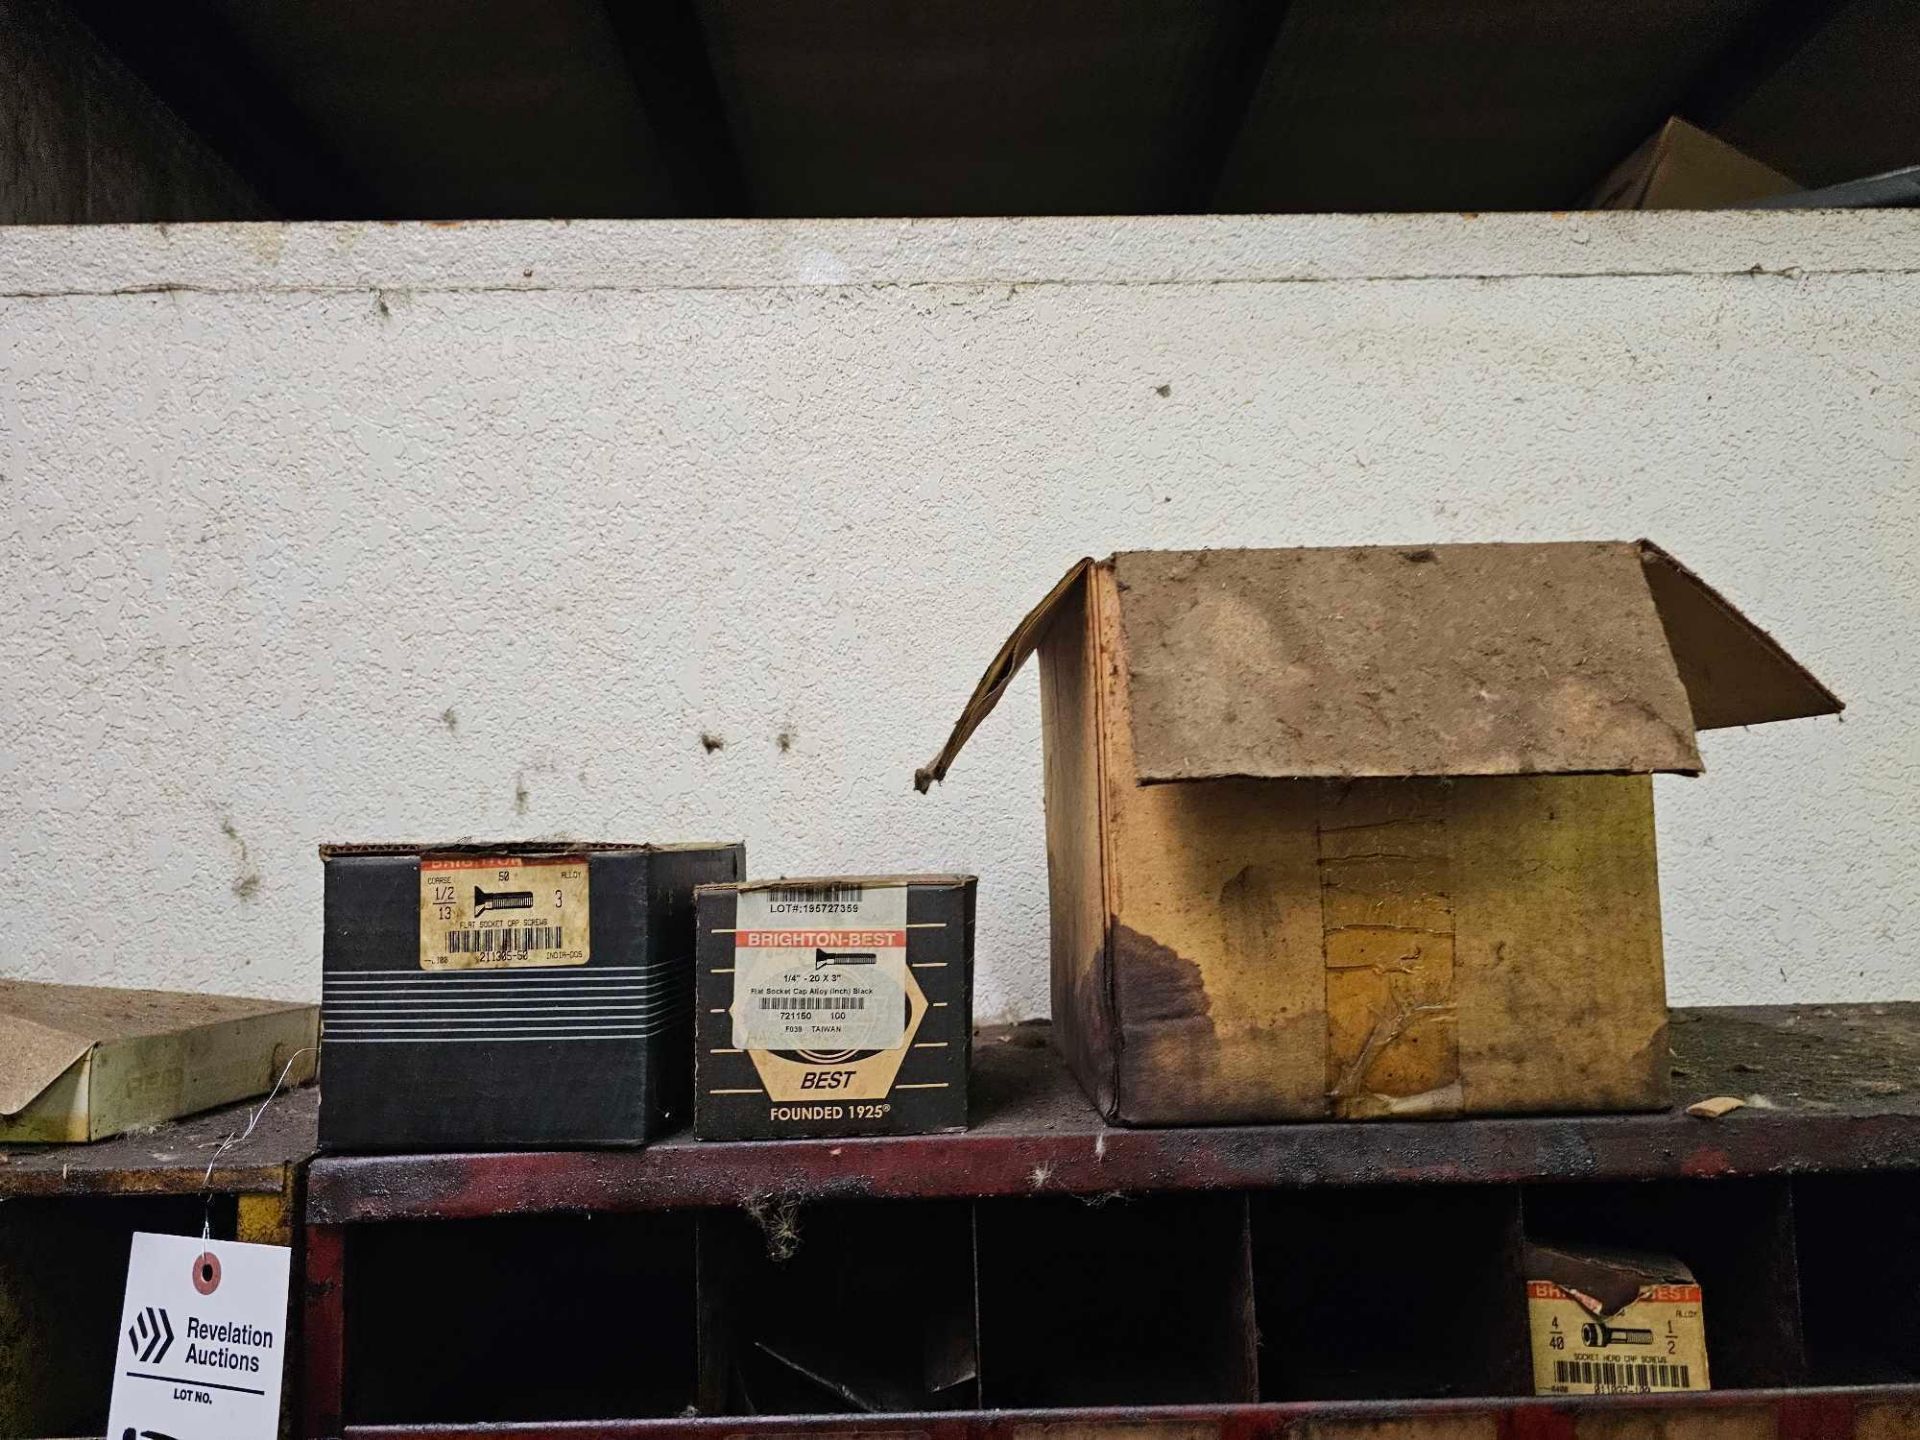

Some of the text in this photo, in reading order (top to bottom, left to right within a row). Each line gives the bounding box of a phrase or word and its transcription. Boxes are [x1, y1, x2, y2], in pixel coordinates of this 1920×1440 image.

[498, 871, 510, 882] 50
[434, 886, 455, 901] 1/2
[554, 889, 563, 909] 3
[438, 906, 452, 920] 13
[459, 918, 548, 929] FLAT SOCKET CAP SCREWS
[747, 932, 897, 947] BRIGHTON-BEST
[809, 974, 820, 982] 20
[823, 974, 829, 982] X
[793, 988, 808, 996] Cap
[809, 988, 828, 996] Alloy
[830, 1012, 846, 1020] 100
[800, 1070, 857, 1090] BEST
[770, 1106, 843, 1121] FOUNDED
[1551, 1316, 1559, 1330] 4
[1667, 1320, 1673, 1334] 1
[186, 1317, 273, 1348] Revelation
[1549, 1336, 1564, 1350] 40
[1667, 1341, 1676, 1355] 2
[185, 1343, 260, 1373] Auctions
[1573, 1353, 1599, 1361] SOCKET
[1603, 1354, 1621, 1362] HEAD
[1641, 1356, 1667, 1364] SCREWS
[173, 1388, 213, 1404] LOT NO.
